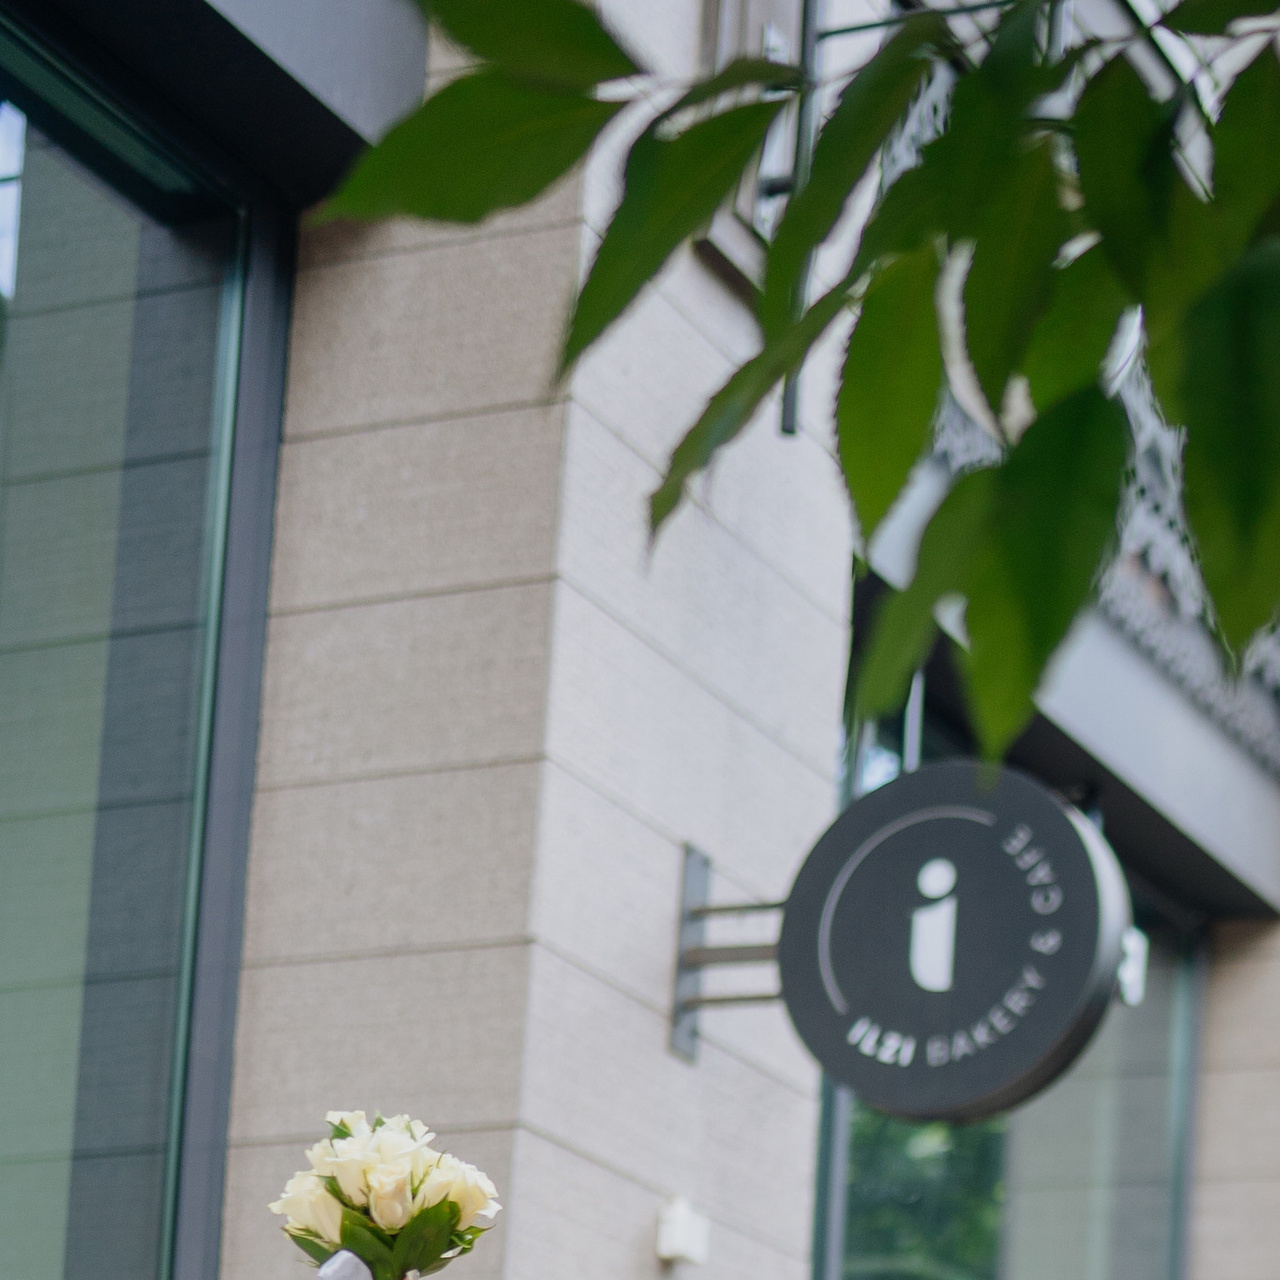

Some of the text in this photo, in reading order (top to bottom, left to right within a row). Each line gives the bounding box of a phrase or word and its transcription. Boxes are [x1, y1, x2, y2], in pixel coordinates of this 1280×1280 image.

[1003, 824, 1063, 915] CAFE
[910, 858, 957, 992] i
[1031, 927, 1062, 955] &
[927, 965, 1046, 1067] BAKERY
